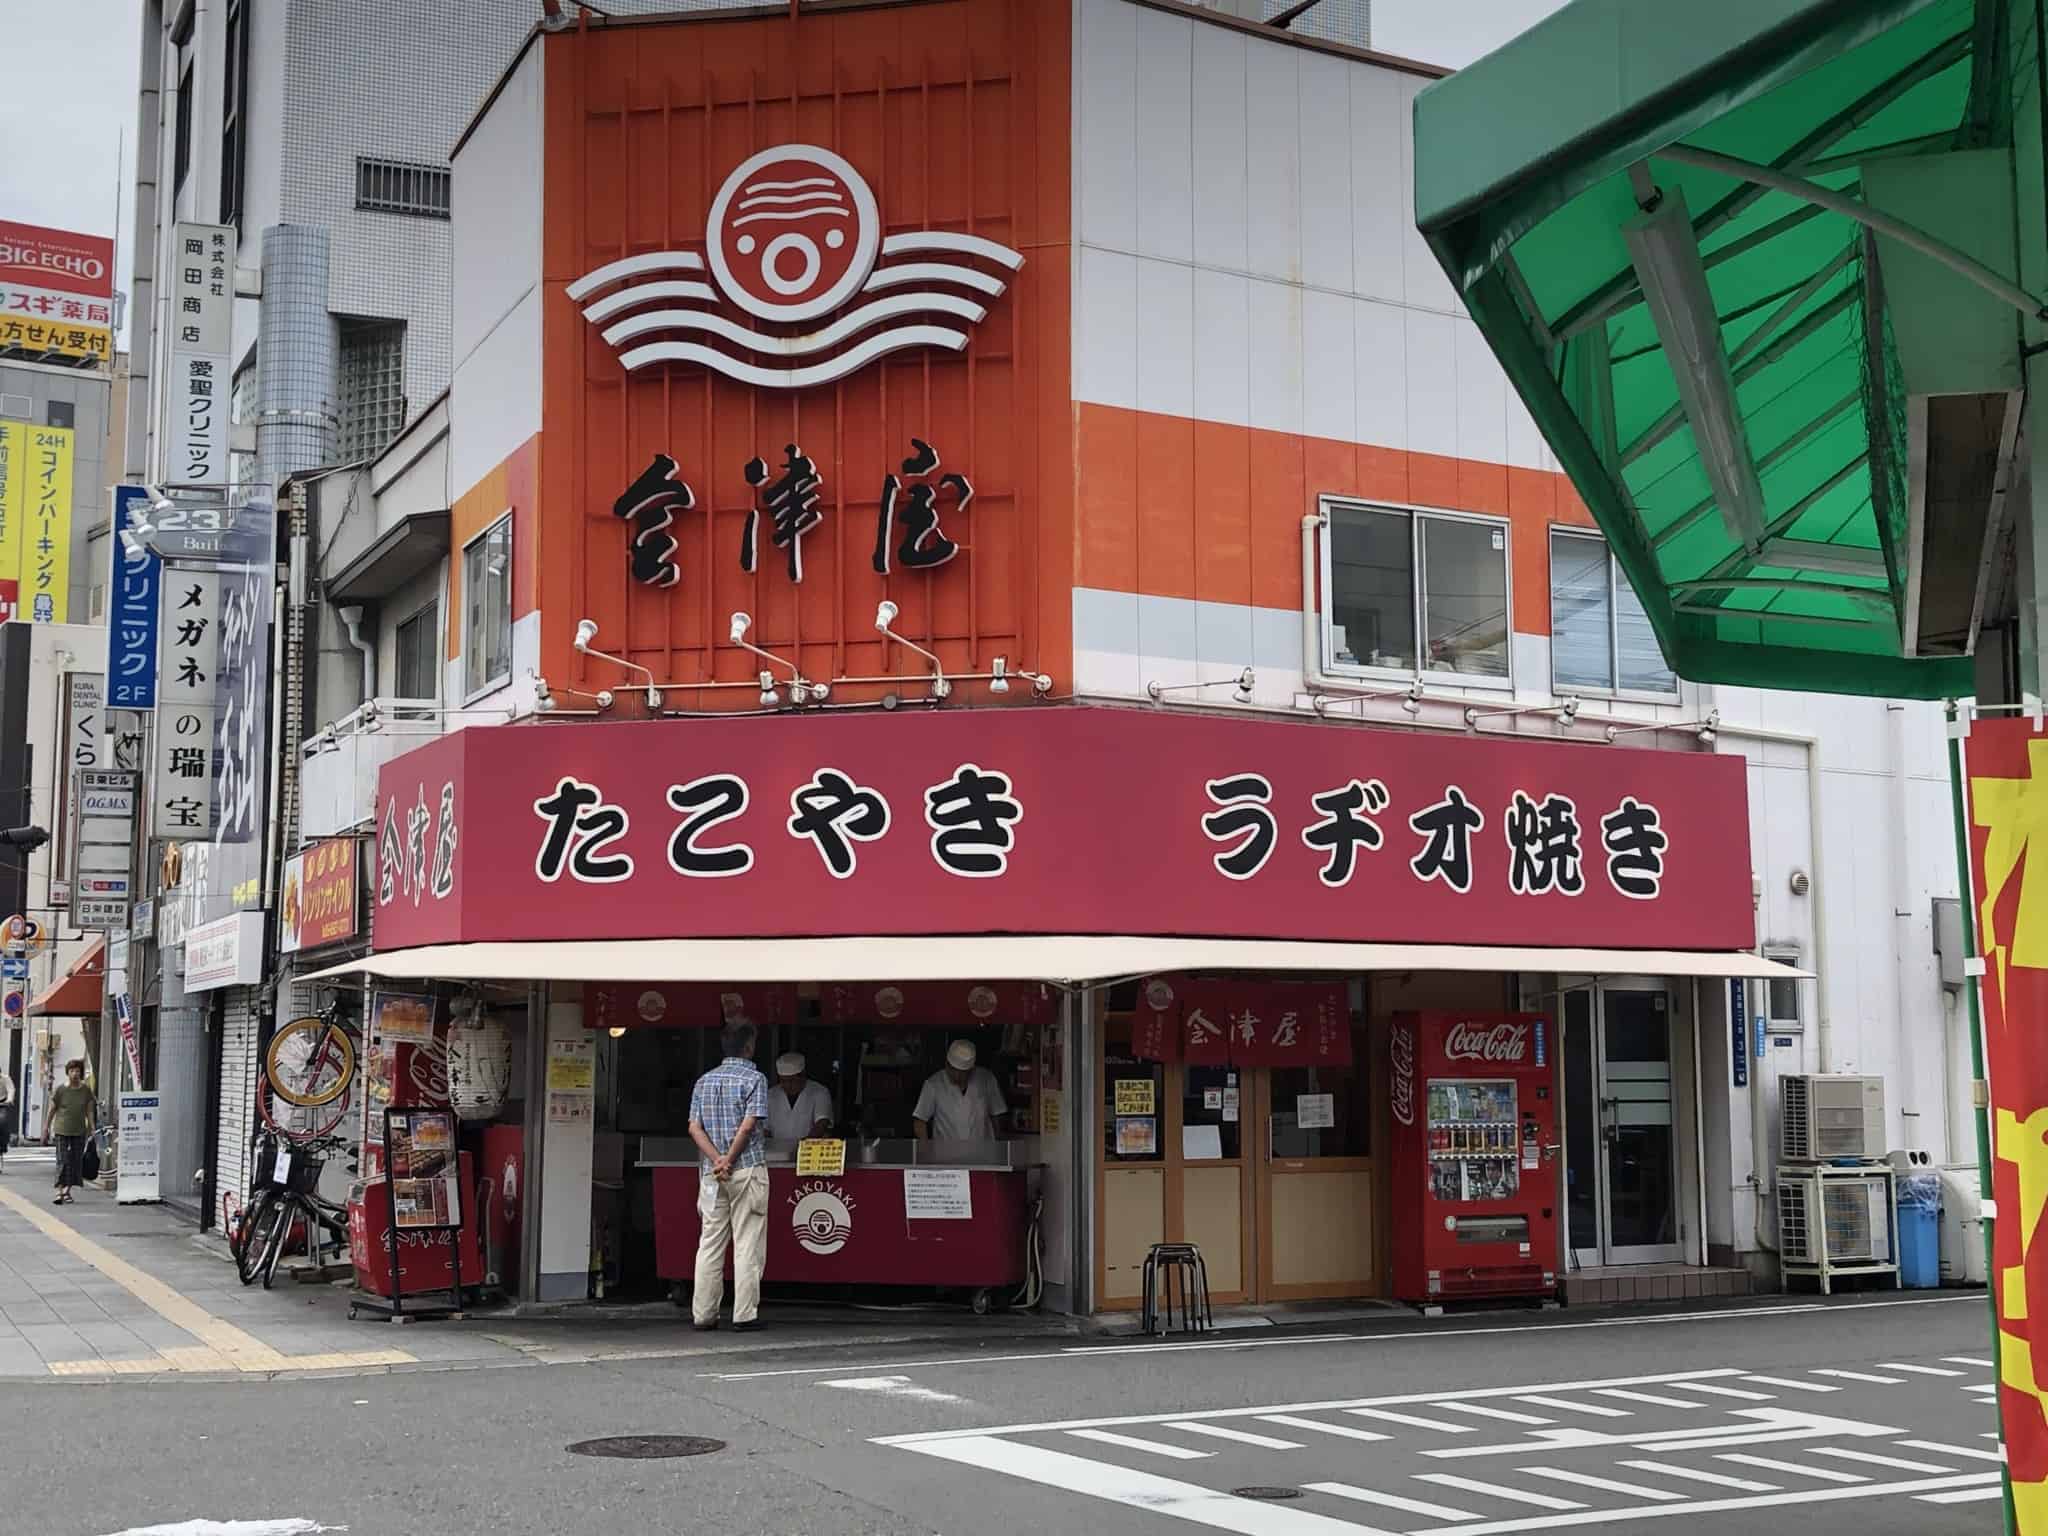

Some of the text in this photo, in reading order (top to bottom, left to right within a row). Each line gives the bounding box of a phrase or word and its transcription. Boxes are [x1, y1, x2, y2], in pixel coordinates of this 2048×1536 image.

[0, 244, 104, 280] BIG ECHO
[182, 238, 204, 343] 岡田商店
[209, 233, 226, 297] 株式会社
[0, 321, 106, 353] 方せん受付
[8, 292, 109, 324] スギ薬局
[36, 433, 66, 449] 24H
[186, 360, 214, 480] 愛聖クリニック
[36, 450, 57, 590] コインパーキング
[612, 437, 976, 589] 会津屋
[116, 685, 147, 702] 2F
[165, 584, 209, 827] メガネの瑞宝
[533, 763, 1025, 884] たこやき
[1201, 773, 1669, 900] ラヂオ焼き
[1187, 1007, 1301, 1048] 会津屋
[787, 1180, 857, 1210] TAKOYAKI
